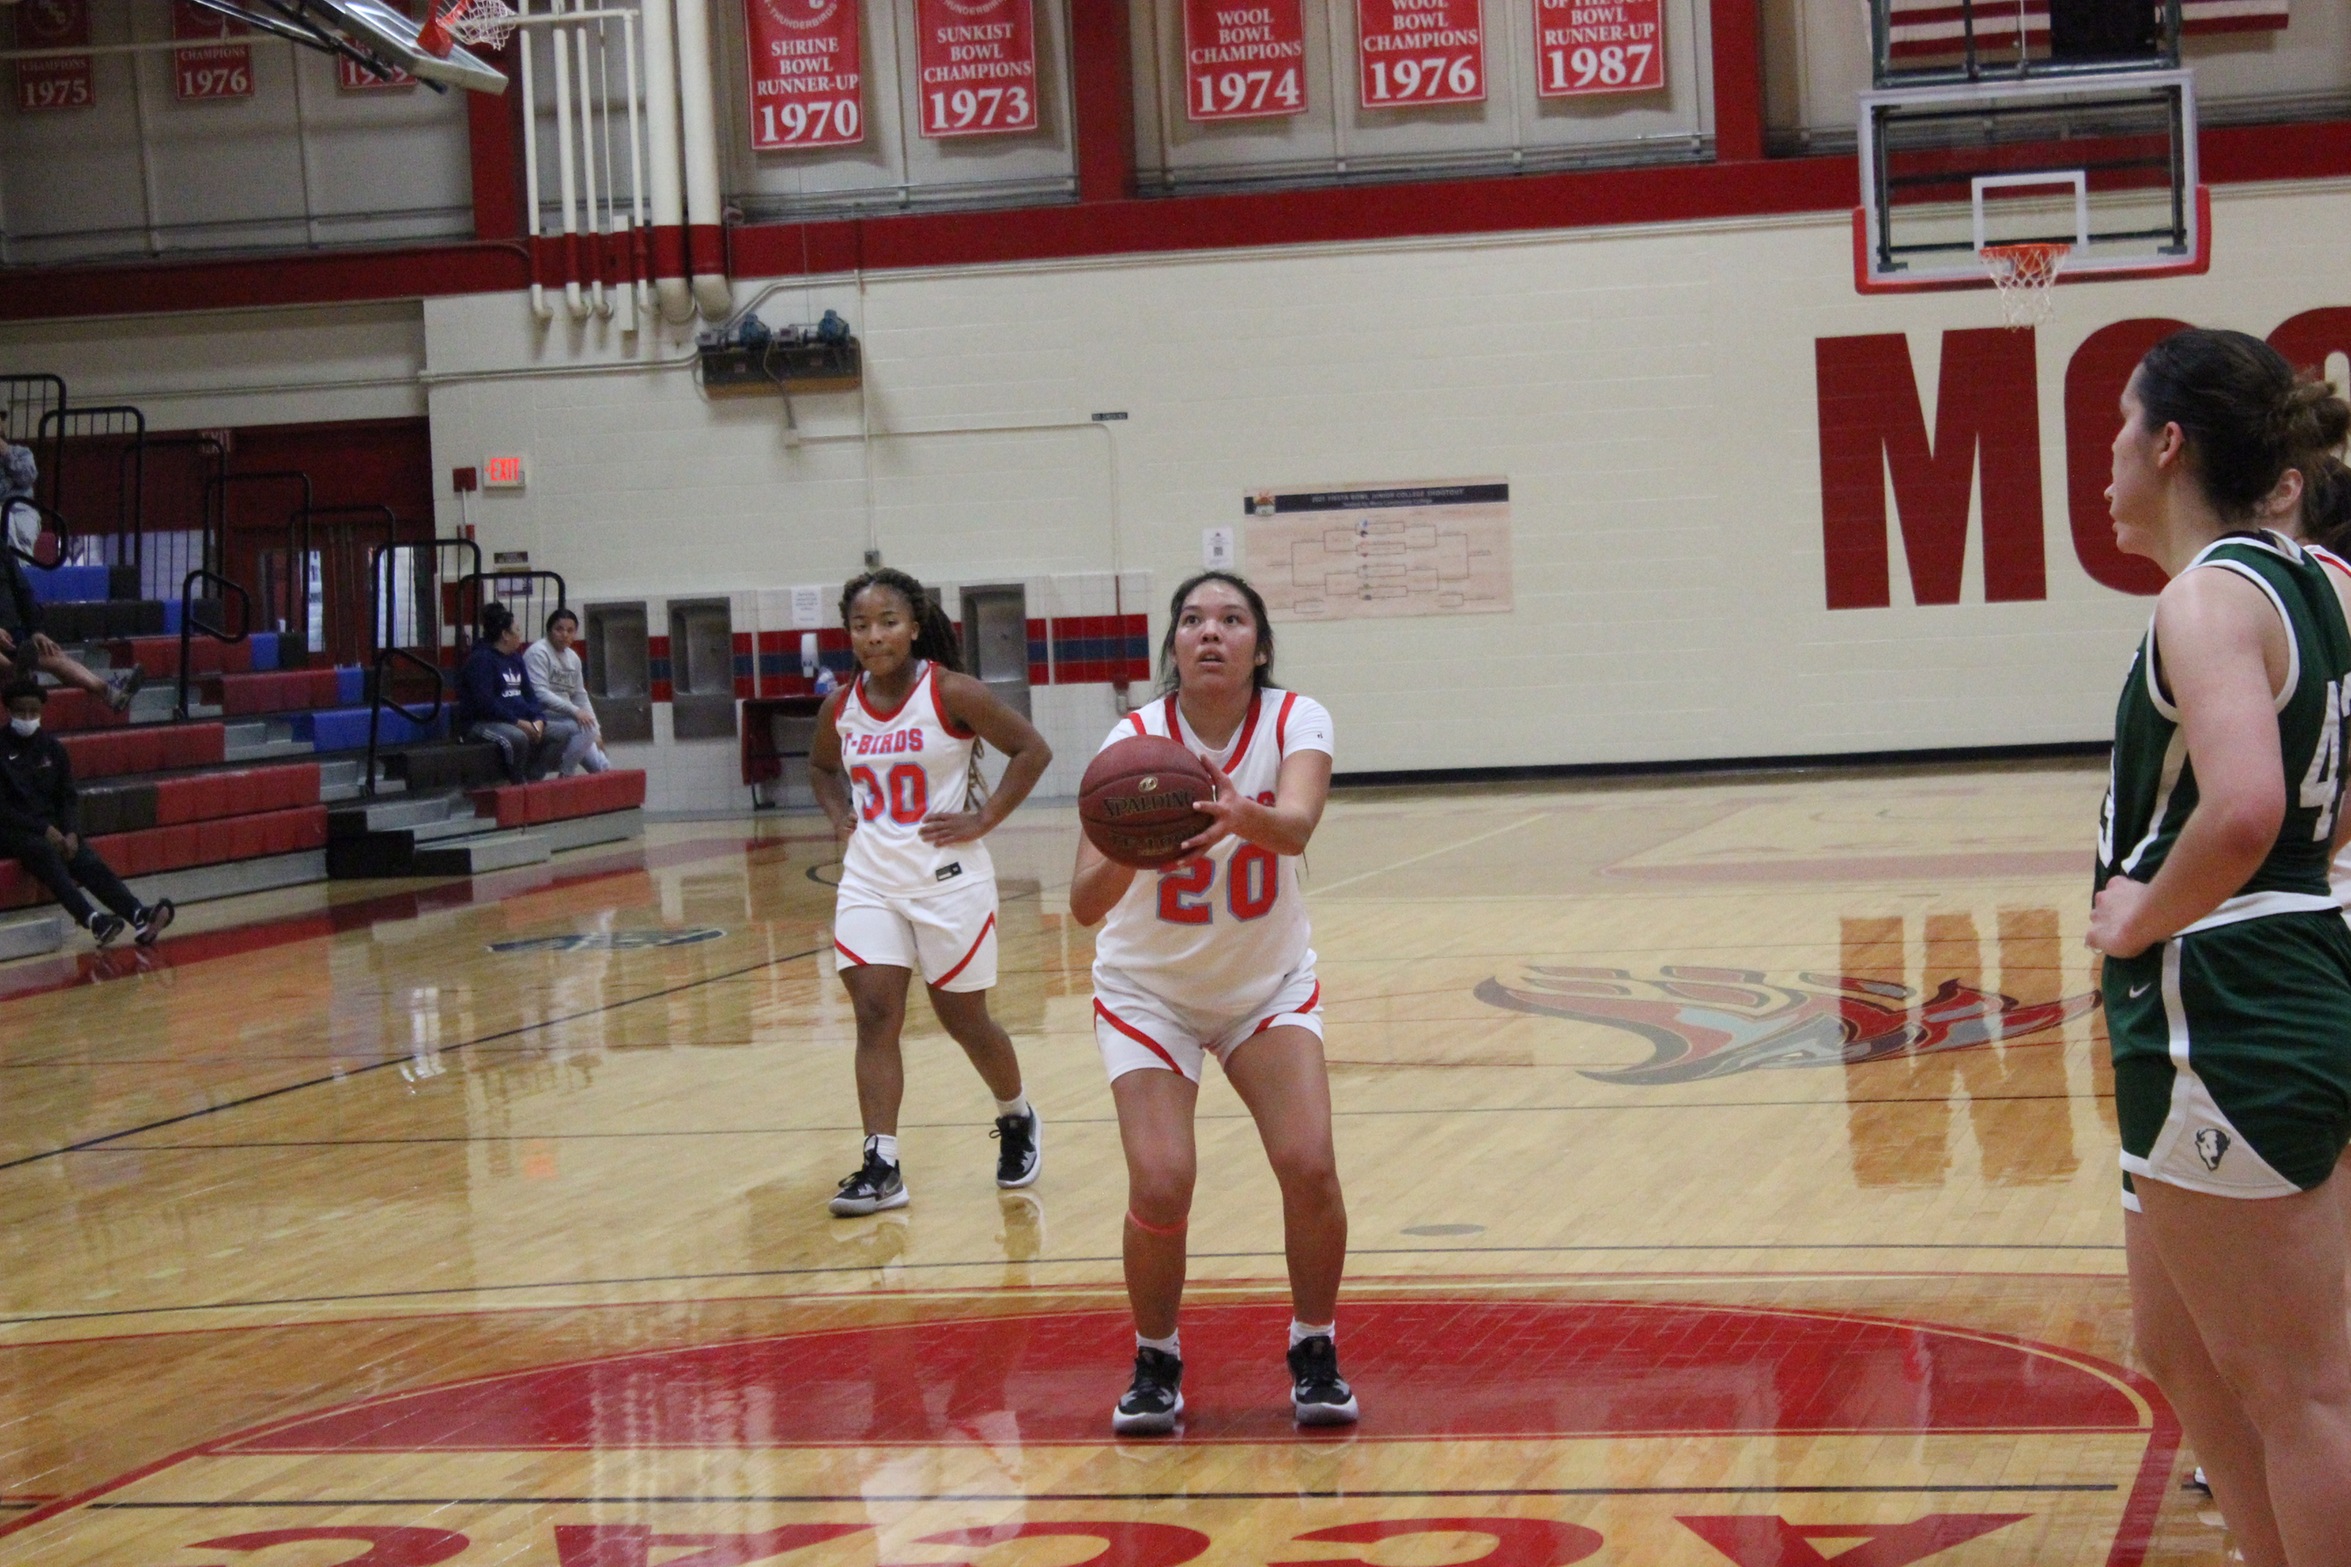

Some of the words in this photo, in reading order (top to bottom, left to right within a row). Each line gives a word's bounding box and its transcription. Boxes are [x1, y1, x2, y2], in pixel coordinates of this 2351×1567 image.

[1217, 8, 1275, 26] WOOL
[1393, 12, 1449, 31] BOWL
[1571, 7, 1628, 25] BOWL
[937, 22, 1014, 43] SUNKIST
[1219, 25, 1275, 44] BOWL
[1364, 29, 1478, 52] CHAMPIONS
[1544, 22, 1655, 46] RUNNER-UP
[180, 46, 246, 60] CHAMPIONS
[771, 37, 840, 56] SHRINE
[950, 43, 1004, 62] BOWL
[1191, 41, 1301, 64] CHAMPIONS
[779, 57, 834, 75] BOWL
[924, 61, 1032, 83] CHAMPIONS
[1370, 54, 1476, 99] 1976
[1547, 43, 1653, 88] 1987
[25, 79, 88, 106] 1975
[183, 67, 248, 96] 1976
[757, 74, 859, 96] RUNNER-UP
[1197, 68, 1300, 112] 1974
[930, 86, 1029, 129] 1973
[761, 99, 858, 142] 1970
[491, 457, 520, 481] EXIT
[843, 728, 923, 756] T-BIRDS
[850, 761, 929, 827] 30
[1156, 842, 1279, 926] 20
